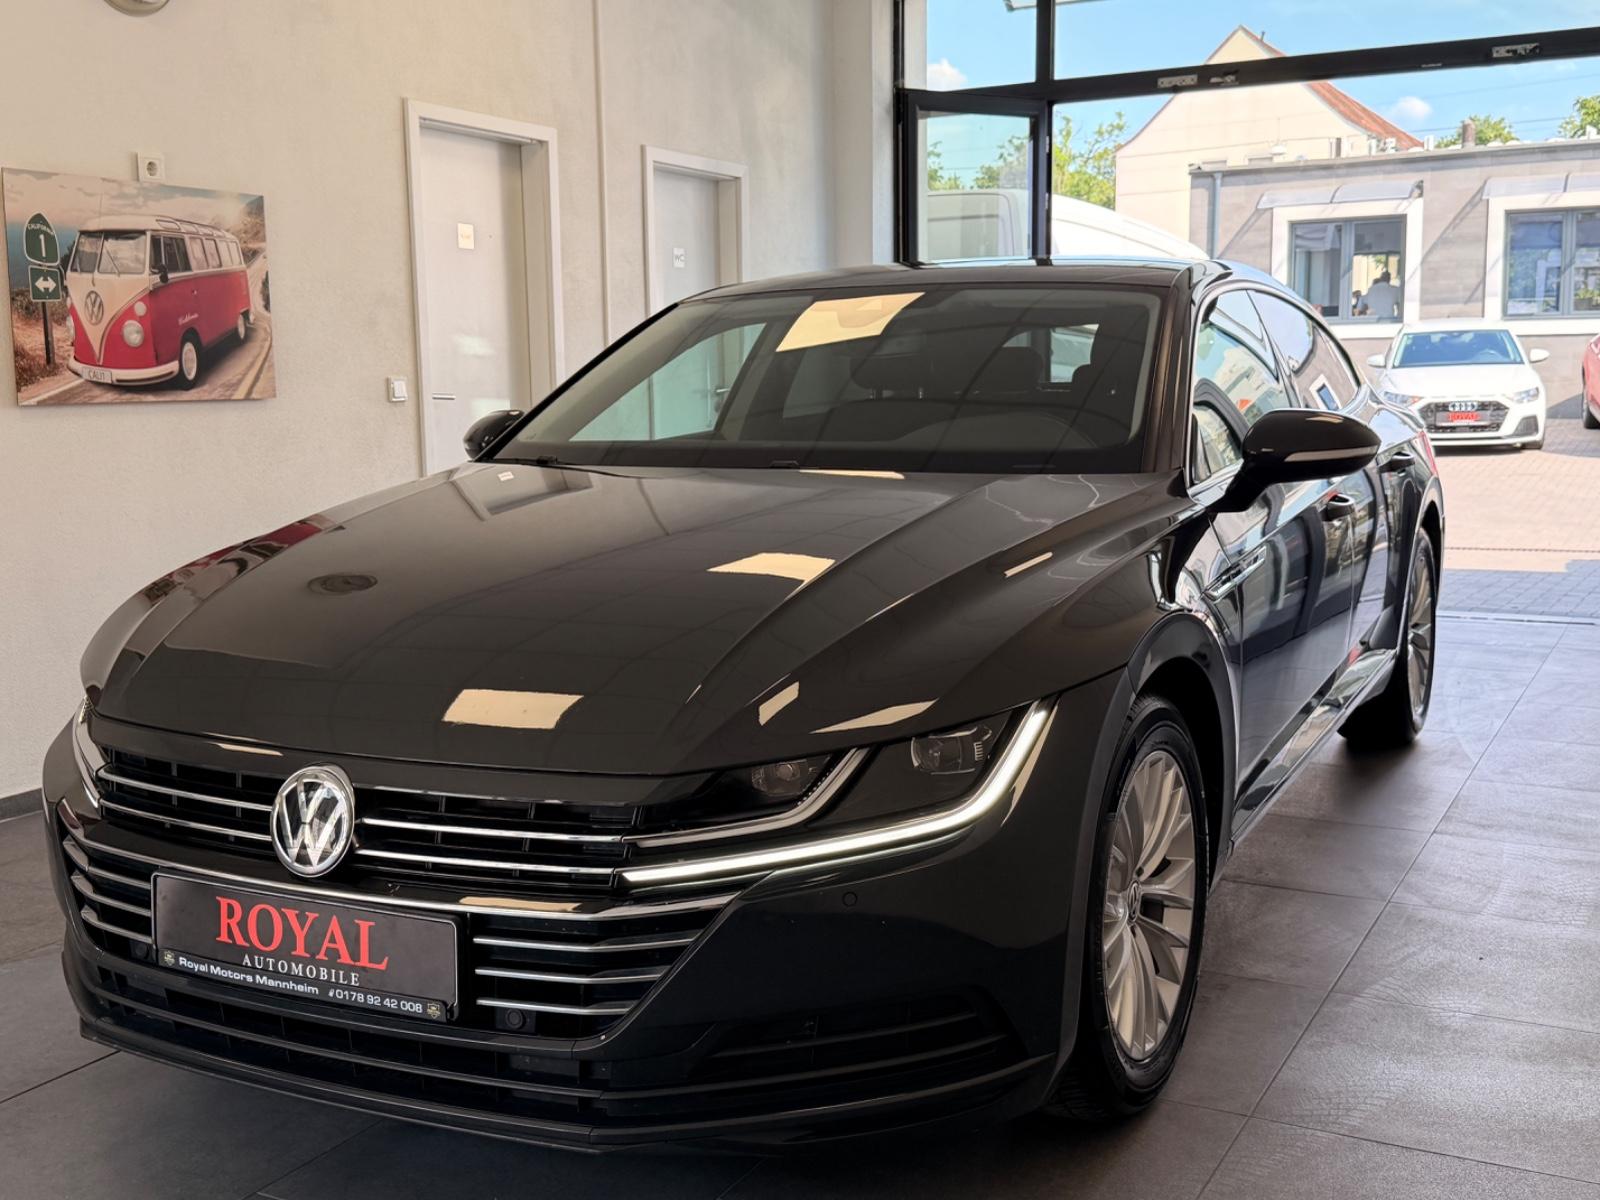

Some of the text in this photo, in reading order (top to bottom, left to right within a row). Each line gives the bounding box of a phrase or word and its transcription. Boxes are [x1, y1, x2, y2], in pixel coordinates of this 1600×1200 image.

[215, 895, 390, 971] ROYAL
[178, 956, 209, 973] Royal
[210, 964, 254, 983] Motors
[255, 974, 320, 995] Mannheim
[366, 993, 382, 1007] 92
[383, 996, 399, 1010] 42
[400, 1000, 424, 1014] 008
[242, 953, 361, 987] AUTOMOBILE
